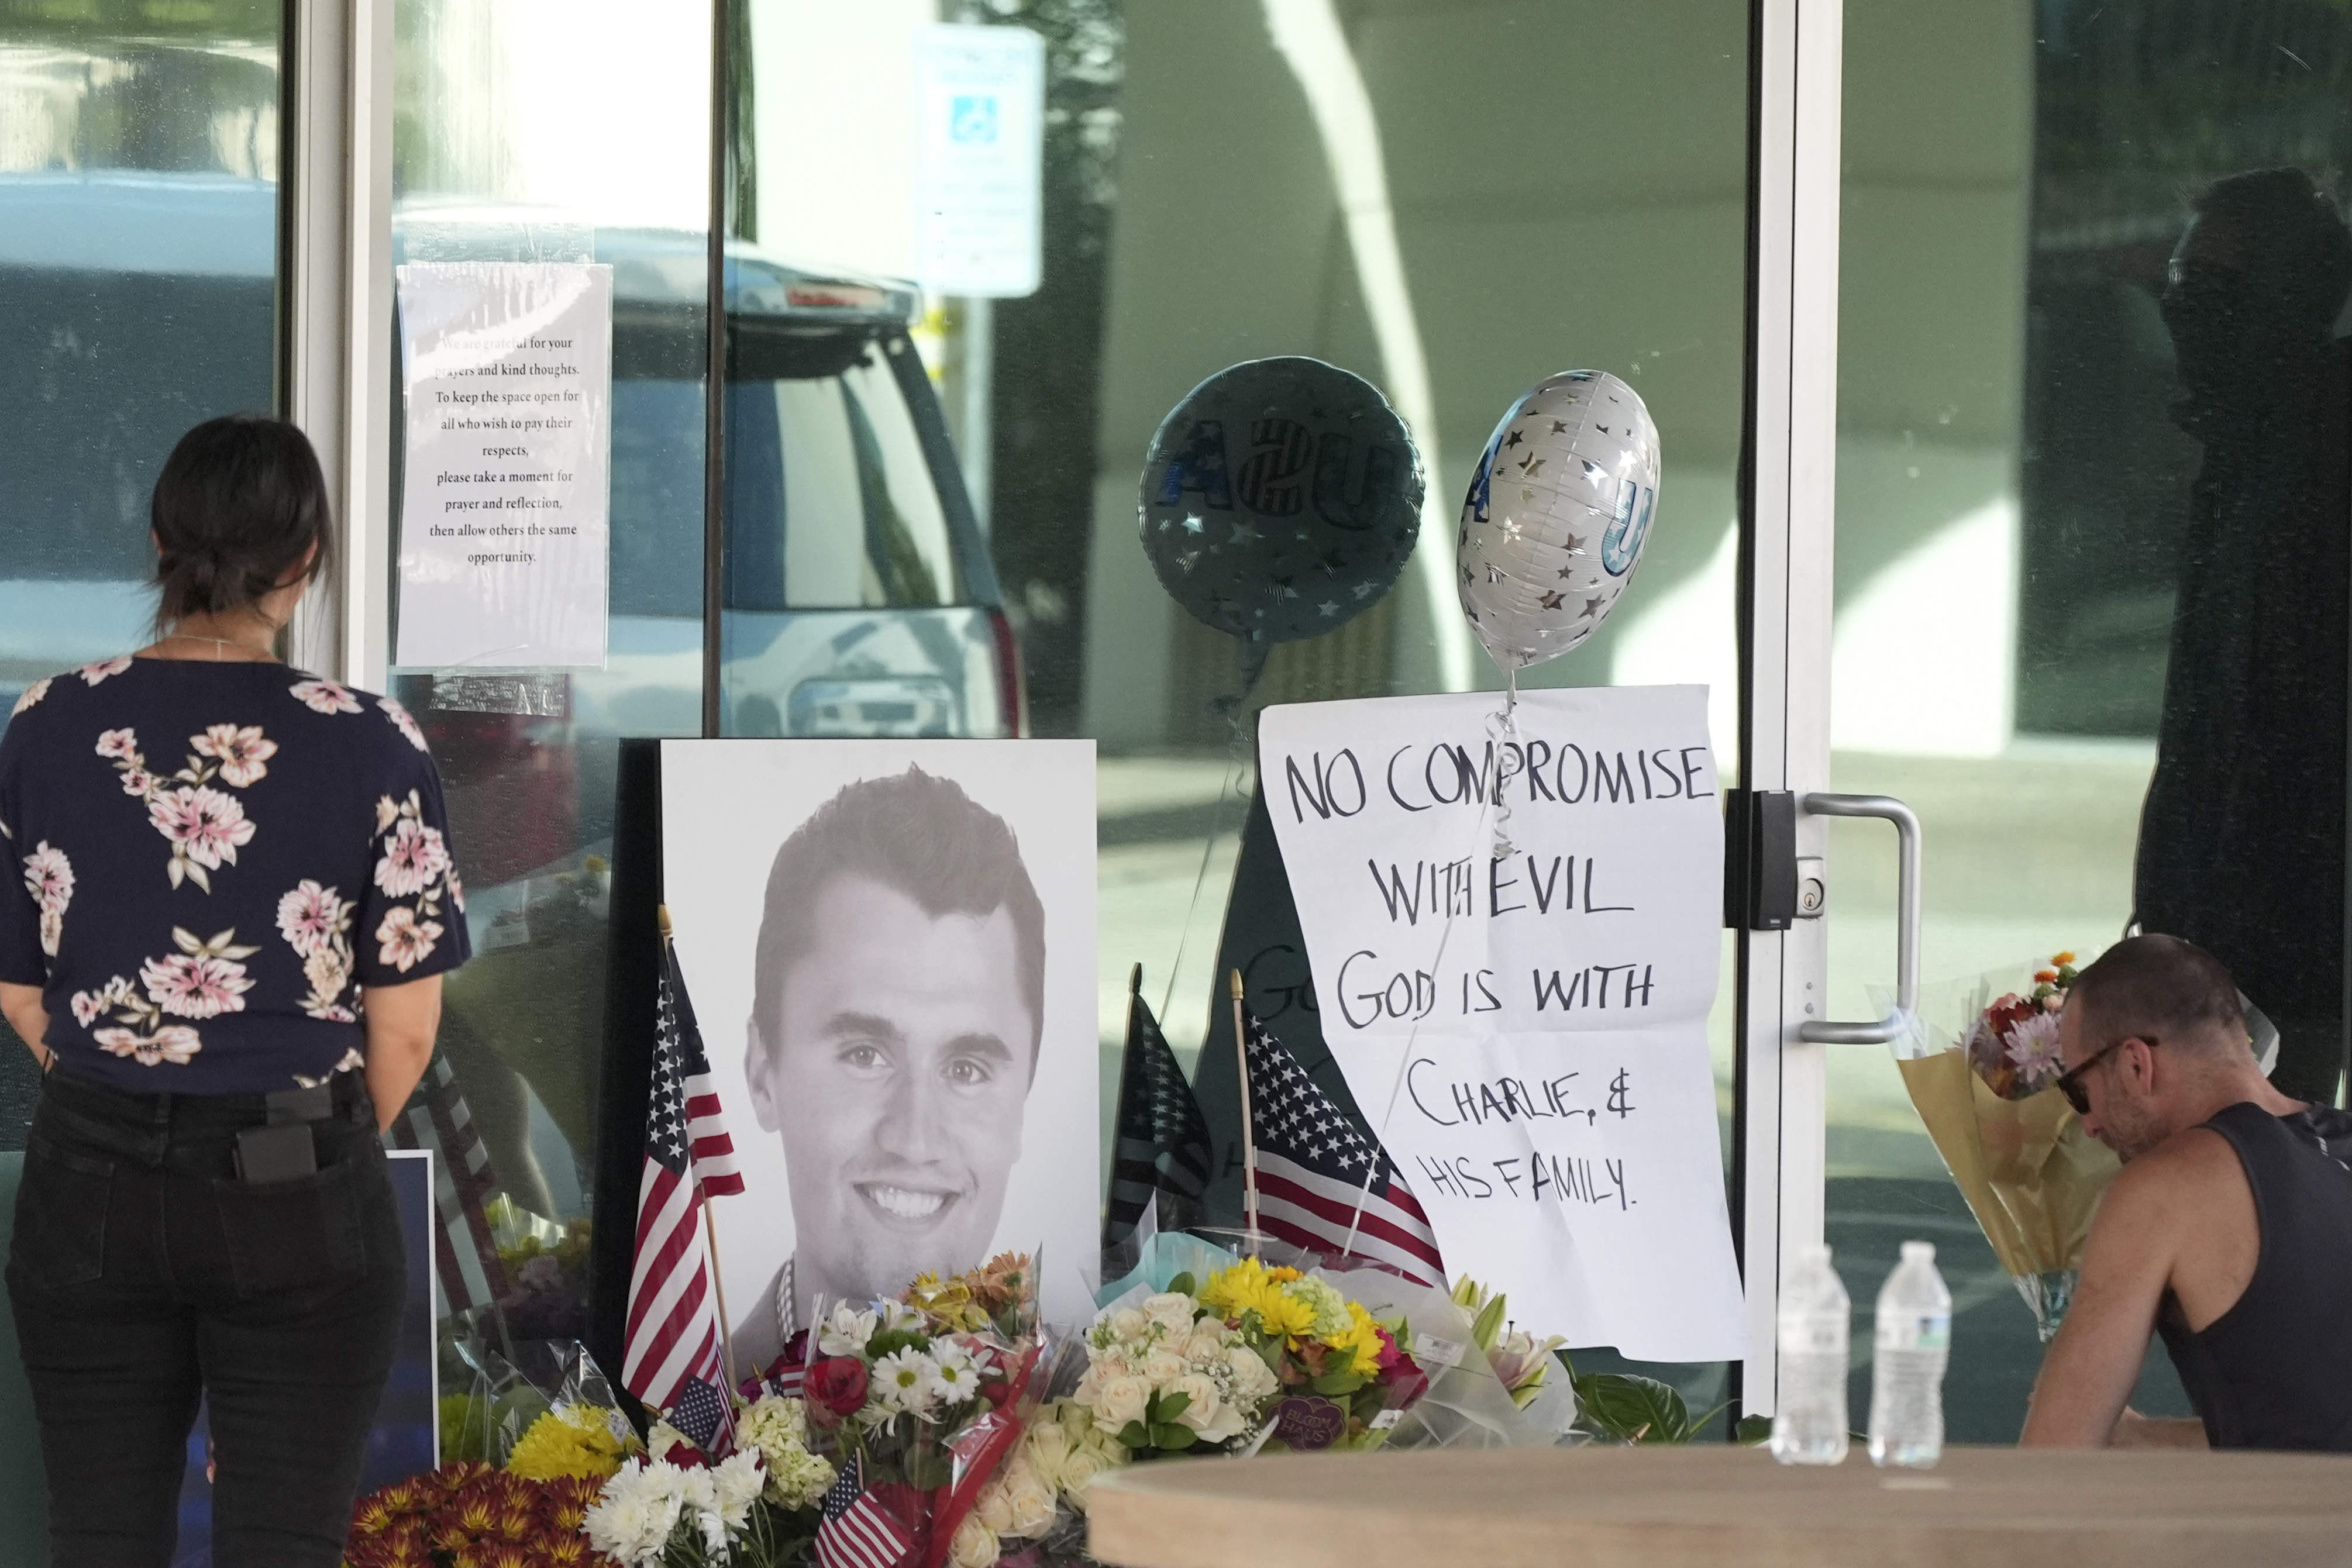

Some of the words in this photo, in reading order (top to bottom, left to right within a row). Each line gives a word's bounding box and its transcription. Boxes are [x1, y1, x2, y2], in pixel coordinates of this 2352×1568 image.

[442, 337, 460, 350] We
[463, 339, 480, 349] are
[483, 337, 526, 351] grateful
[530, 336, 546, 349] for
[549, 339, 573, 352] your
[435, 367, 475, 380] prayers
[478, 363, 498, 376] and
[501, 363, 526, 375] kind
[529, 363, 580, 378] thoughts.
[435, 391, 449, 403] To
[453, 390, 478, 405] keep
[481, 390, 499, 402] the
[502, 392, 531, 405] space
[534, 392, 560, 405] open
[563, 389, 579, 401] for
[441, 417, 454, 429] all
[457, 417, 480, 429] who
[483, 416, 508, 429] wish
[511, 419, 521, 429] to
[525, 419, 543, 432] pay
[546, 416, 573, 428] their
[483, 446, 529, 459] respects,
[437, 471, 470, 487] please
[474, 470, 497, 483] take
[500, 474, 506, 482] a
[509, 472, 554, 482] moment
[557, 469, 573, 482] for
[445, 500, 480, 513] prayer
[482, 497, 502, 509] and
[506, 497, 562, 510] reflection,
[430, 524, 454, 536] then
[457, 523, 487, 536] allow
[490, 523, 524, 536] others
[528, 523, 546, 535] the
[548, 527, 577, 535] same
[468, 550, 536, 566] opportunity.
[1286, 747, 1367, 825] NO
[1386, 739, 1716, 812] COMPROMISE
[1368, 855, 1474, 927] WITH
[1489, 850, 1635, 919] EVIL
[1462, 969, 1503, 1015] IS
[1533, 964, 1655, 1013] WITH
[1606, 1067, 1637, 1119] &
[1415, 1155, 1493, 1199] HIS
[1493, 1150, 1638, 1212] FAMILY.
